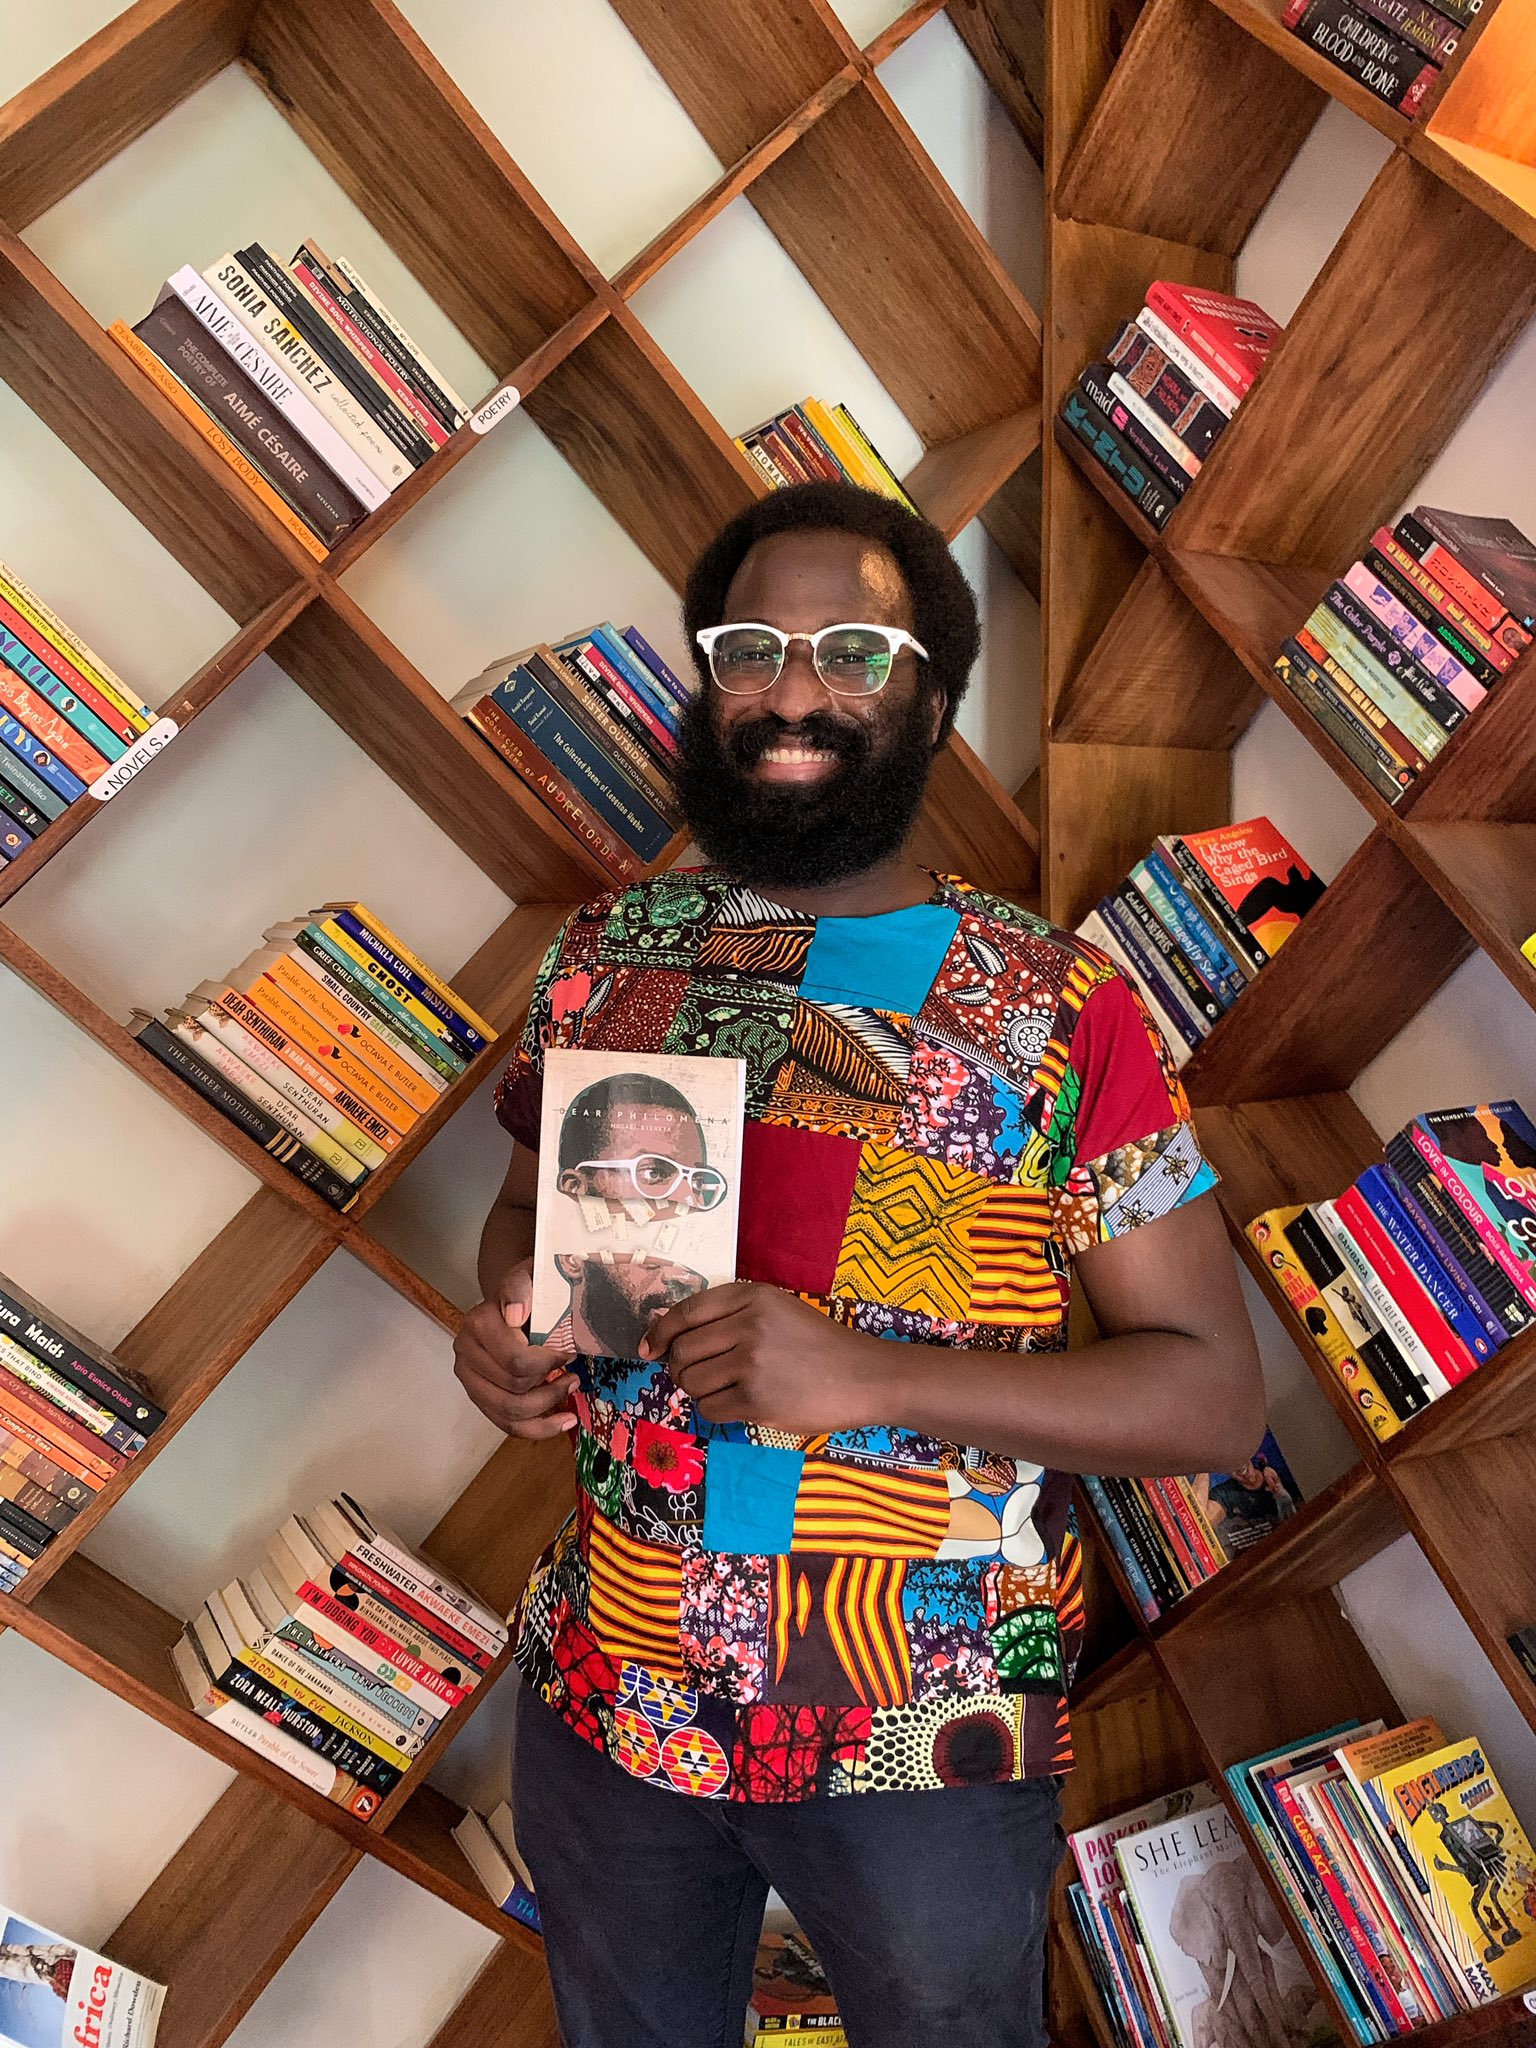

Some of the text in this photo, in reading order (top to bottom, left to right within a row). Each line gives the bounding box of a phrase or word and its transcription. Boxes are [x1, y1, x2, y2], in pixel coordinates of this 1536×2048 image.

[1309, 22, 1402, 98] BLOOD BONE
[1333, 12, 1395, 63] CHILDREN
[215, 263, 268, 319] SONIA
[260, 315, 334, 394] SANCHEZ
[306, 281, 376, 361] DIVINE SOUL WHISPERS
[411, 408, 430, 428] KING
[477, 391, 512, 425] POETRY
[1082, 375, 1121, 416] maid
[205, 426, 263, 488] LOST BODY
[220, 387, 263, 430] AIMÉ
[253, 423, 313, 484] CÉSAIRE
[740, 449, 773, 485] PASSION
[286, 517, 324, 555] BRAZILLER
[1415, 572, 1430, 587] THE
[1327, 589, 1390, 657] The Color Purple
[558, 668, 575, 687] LORDE
[597, 659, 618, 683] DIVINE
[614, 680, 630, 697] SOUL
[628, 695, 654, 725] WHISPERS
[9, 690, 77, 754] Begins Again
[580, 693, 610, 727] SISTER
[606, 722, 649, 771] OUTSIDER
[1350, 719, 1391, 765] LYNCHING TREE
[107, 736, 164, 790] NOVELS
[550, 731, 629, 817] The Collected of Langston
[611, 749, 667, 812] QUESTIONS FOR ADA
[536, 773, 616, 863] AUDRE LORDE
[1199, 838, 1246, 857] I Know
[1203, 847, 1260, 867] Why the
[1212, 848, 1288, 878] Caged Bird
[1220, 872, 1258, 888] Sings
[312, 931, 325, 944] 6th
[357, 927, 413, 981] MICHAELA COEL
[1147, 887, 1220, 982] The Dragonfly Sea
[311, 944, 355, 985] GRIEF CHILD
[350, 966, 377, 991] THE POT
[364, 960, 412, 1005] GHOST
[1136, 958, 1156, 979] Black
[255, 986, 320, 1045] Parable of the Sower
[275, 964, 339, 1023] Parable of the Sower
[319, 973, 372, 1023] SMALL COUNTRY
[367, 996, 413, 1038] Lawrence Darmani
[165, 1042, 268, 1132] THE THREE MOTHERS
[214, 1059, 244, 1085] EMEZI
[222, 991, 389, 1141] DEAR SENTHURAN AKWAEKE EMEZI
[338, 1059, 398, 1113] OCTAVIA BUTLER
[357, 1037, 417, 1093] OCTAVIA BUTLER
[255, 1095, 306, 1138] SENTHURAN
[274, 1099, 299, 1122] DEAR
[282, 1080, 330, 1124] SENTHURAN
[299, 1085, 324, 1108] DEAR
[617, 1111, 728, 1125] PHILOMENA
[1441, 1113, 1464, 1121] SUNDAY
[1417, 1136, 1484, 1226] LOVE IN COLOUR
[1374, 1201, 1461, 1320] THE WATER DANCER
[1400, 1196, 1483, 1314] PRAYER FOR LIVING OKRI
[1484, 1230, 1501, 1250] BOLU
[1332, 1230, 1418, 1353] BAMBARA THE SALT EATERS
[22, 1321, 68, 1360] Maids
[5, 1351, 42, 1381] THAT BIND
[110, 1388, 134, 1408] Otuko
[24, 1432, 51, 1453] at Ease
[1122, 1499, 1150, 1540] BLACKNESS
[1175, 1505, 1203, 1545] LAWINO
[1184, 1494, 1217, 1548] BORN CRIME
[1108, 1499, 1160, 1590] SAVAGES CHRIS STUCK
[354, 1543, 492, 1646] FRESHWATER AKWAEKE EMEZI
[319, 1600, 379, 1645] JUDGING YOU
[386, 1613, 454, 1665] WILL ABOUT PLACE
[270, 1647, 306, 1676] DANCE OF THE
[283, 1624, 349, 1674] THE MOTHERS
[390, 1649, 448, 1695] LUVVIE AJAYI
[228, 1671, 322, 1741] ZORA NEALE HURSTON
[307, 1696, 328, 1715] EYE
[229, 1716, 319, 1779] BUTLER Parable of the Sower
[333, 1713, 376, 1746] JACKSON
[1394, 1749, 1485, 1826] ENGINERDS
[1134, 1831, 1186, 1871] SHE
[1290, 1812, 1330, 1879] CLASS ACT
[1349, 1924, 1366, 1948] CRAFT
[1465, 1967, 1488, 1998] MAX
[1475, 1963, 1499, 1993] MAX
